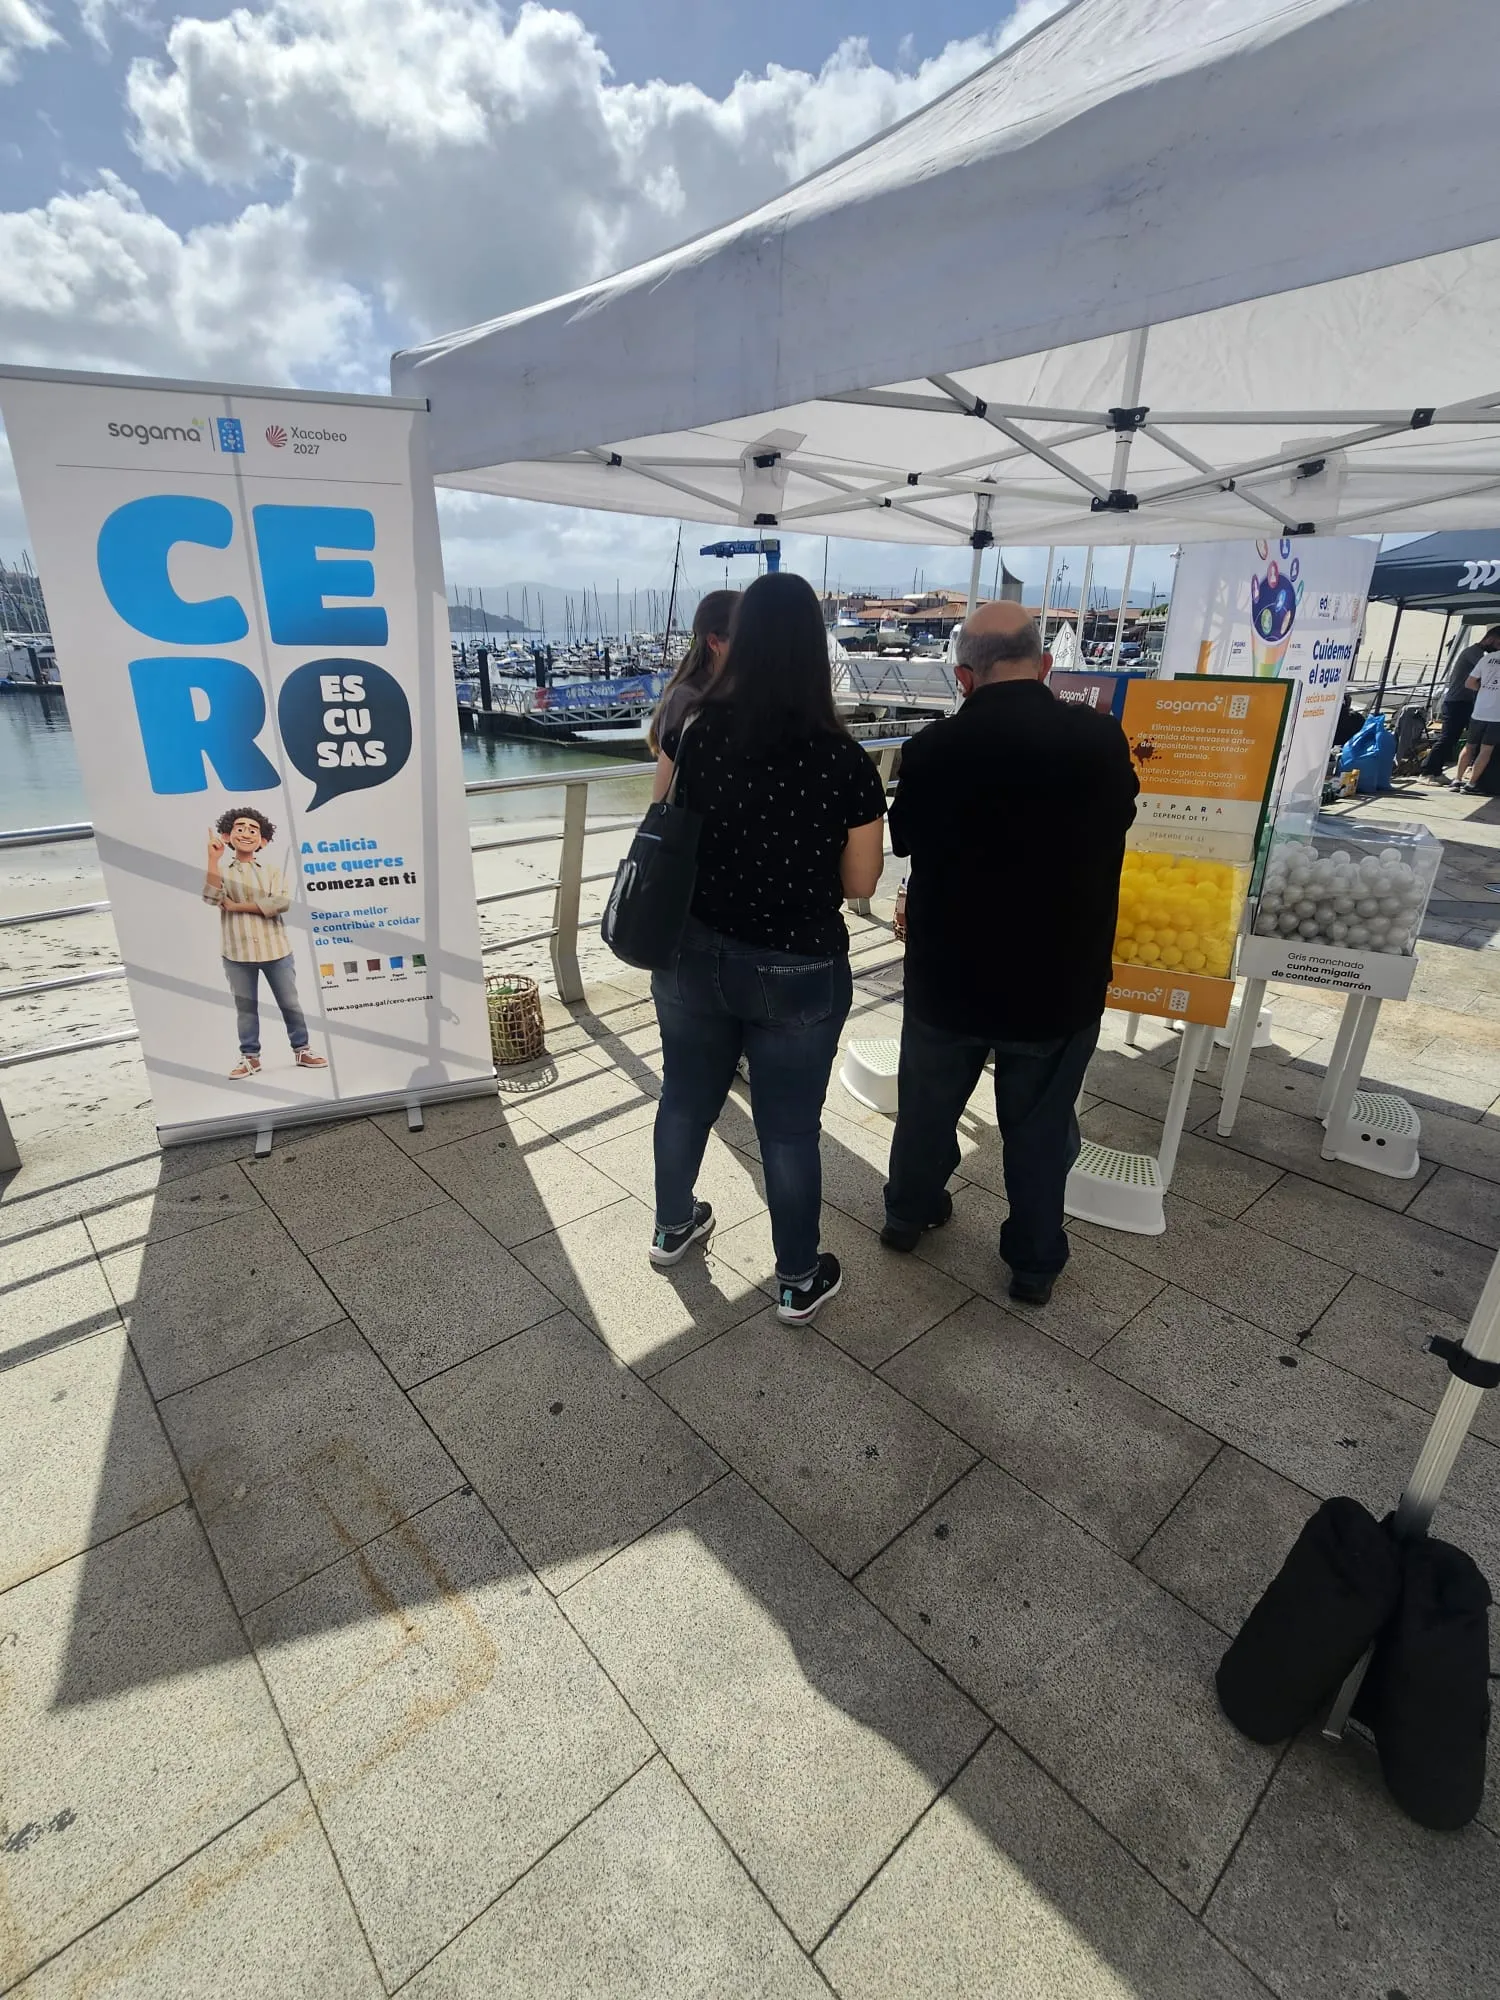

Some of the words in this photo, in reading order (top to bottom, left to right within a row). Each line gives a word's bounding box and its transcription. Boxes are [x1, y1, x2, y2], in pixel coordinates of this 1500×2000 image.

[107, 422, 201, 445] sogama
[290, 427, 347, 442] Xacobeo
[293, 444, 320, 455] 2027
[1313, 637, 1352, 660] Cuidemos
[1308, 664, 1319, 684] el
[320, 675, 367, 702] ES
[1060, 690, 1085, 703] sogama
[1156, 699, 1218, 714] sogama
[323, 708, 371, 735] CU
[1152, 724, 1181, 732] Elimina
[1218, 727, 1244, 735] restos
[1141, 740, 1150, 748] de
[1151, 741, 1198, 750] depositalos
[1211, 743, 1248, 753] contedor
[1231, 737, 1256, 745] antes
[317, 741, 387, 767] SAS
[1173, 752, 1209, 760] amarelo.
[1140, 766, 1171, 775] materia
[1208, 770, 1232, 779] agora
[1170, 776, 1205, 785] contedor
[1153, 812, 1186, 821] DEPENDE
[301, 842, 314, 854] A
[317, 838, 378, 853] Galicia
[303, 861, 337, 875] que
[341, 857, 404, 873] queres
[307, 878, 375, 892] comeza
[379, 875, 400, 886] en
[403, 872, 417, 884] ti
[311, 909, 350, 921] Separa
[353, 906, 388, 916] mellor
[313, 925, 320, 933] e
[387, 916, 420, 926] coidar
[315, 937, 329, 946] do
[332, 935, 353, 944] teu.
[1288, 952, 1307, 961] Gris
[1308, 955, 1364, 970] manchado
[1271, 969, 1284, 977] de
[1285, 972, 1331, 984] contedor
[1287, 963, 1319, 973] cunha
[1321, 967, 1360, 979] migalla
[1106, 984, 1158, 1002] ogama
